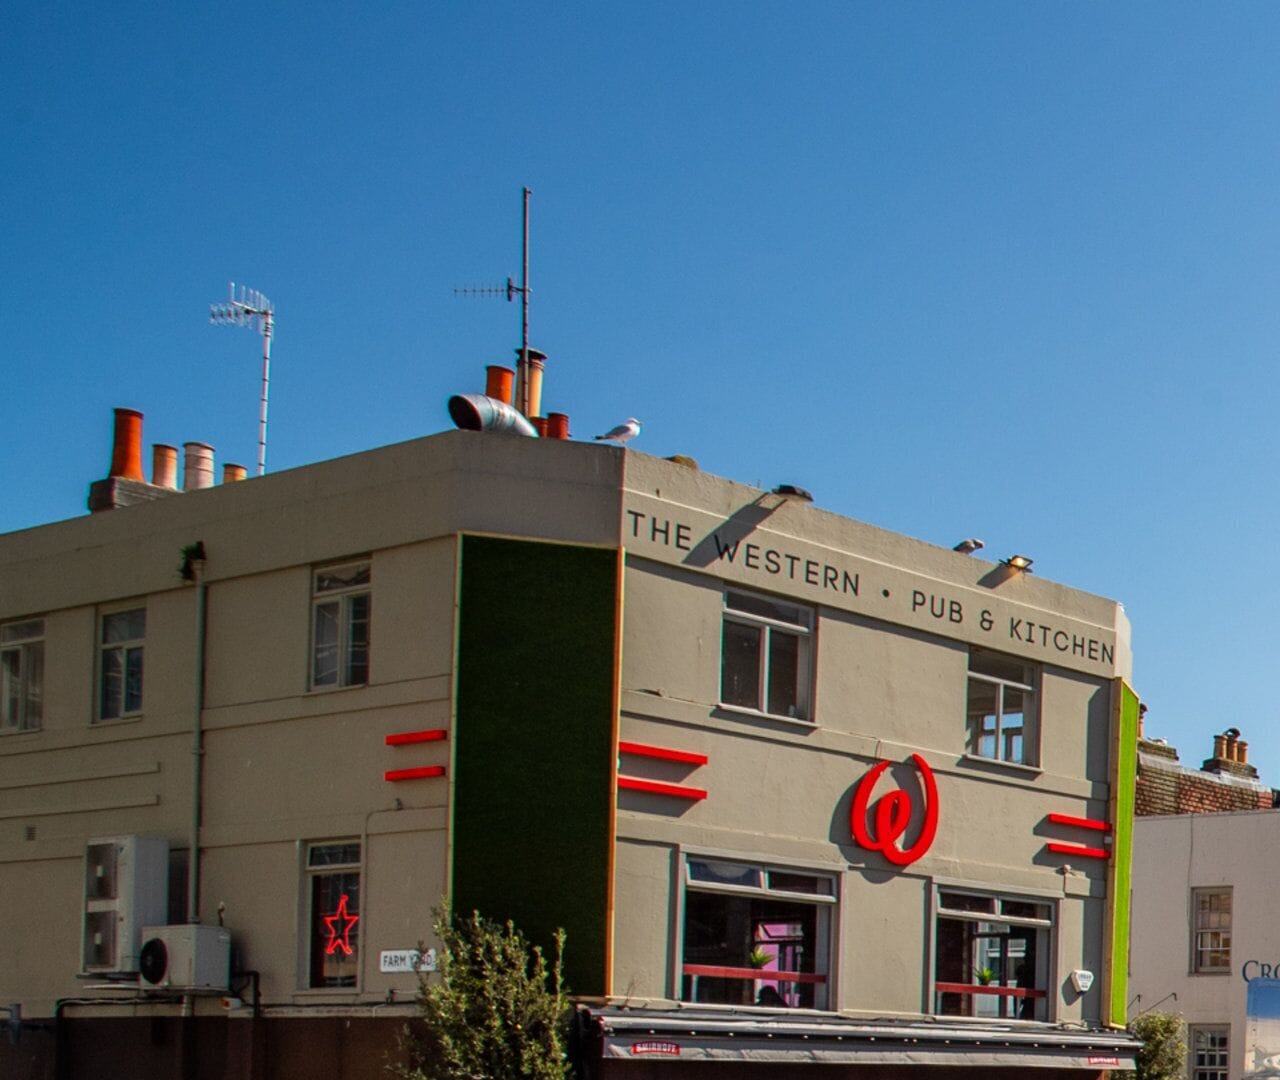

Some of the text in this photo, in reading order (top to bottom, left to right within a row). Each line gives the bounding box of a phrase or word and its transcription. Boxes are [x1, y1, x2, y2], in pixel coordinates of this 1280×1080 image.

[626, 509, 1115, 665] THE WESTERN PUB & KITCHEN
[383, 954, 433, 967] FARM YAD
[636, 1043, 677, 1053] SMIRNOFF
